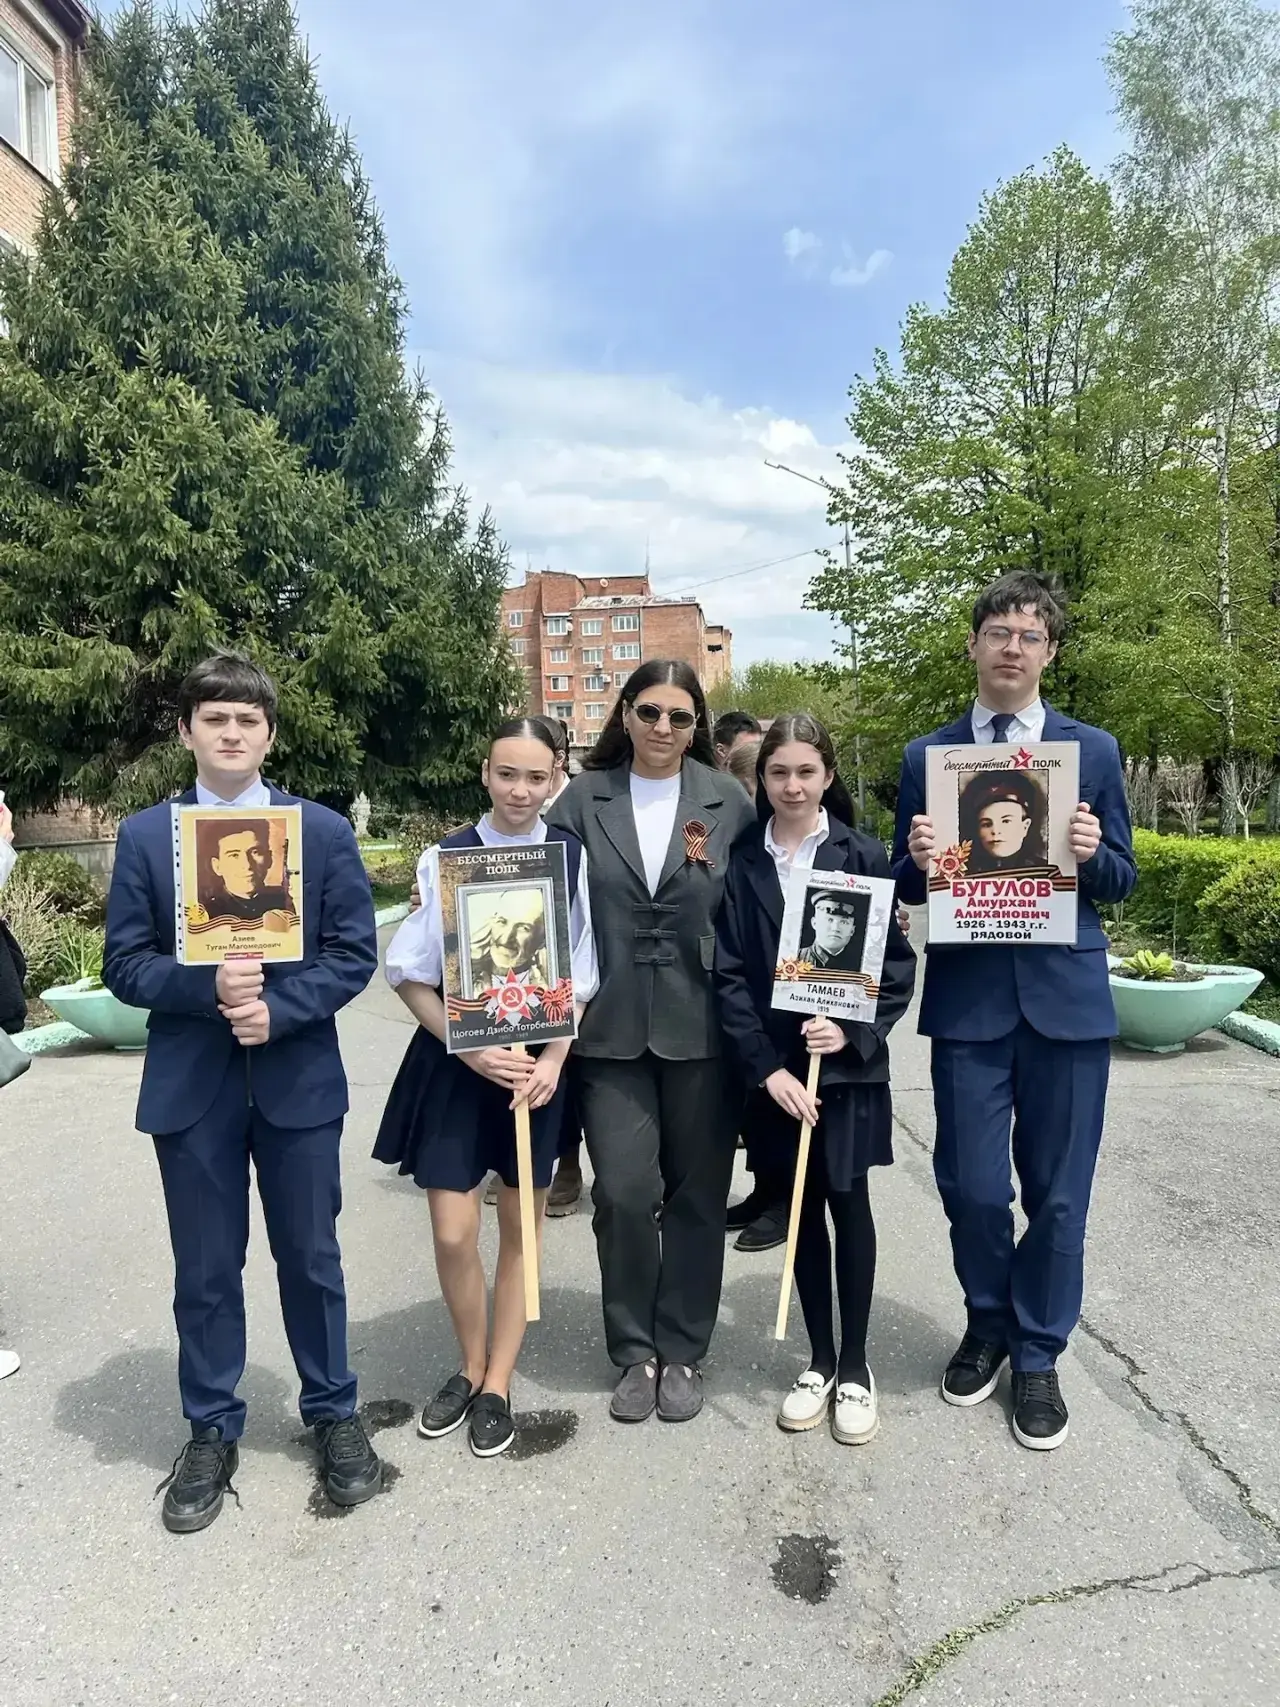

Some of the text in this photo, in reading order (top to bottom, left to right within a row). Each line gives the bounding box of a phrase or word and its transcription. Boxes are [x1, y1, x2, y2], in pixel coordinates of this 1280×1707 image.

[457, 849, 546, 865] БЕССМЕРТНЫЙ
[486, 864, 520, 875] ПОЛК
[952, 880, 1051, 898] БУГУЛОВ
[967, 897, 1036, 909] Амурхан
[954, 908, 1050, 919] Алиханович
[956, 920, 985, 929] 1926
[996, 920, 1026, 929] 1943
[971, 928, 1032, 940] рядовой
[229, 942, 281, 950] Магомедович
[807, 983, 846, 998] ТАМАЕВ
[452, 1019, 570, 1039] Цогоев Дзибо Тотрбекович
